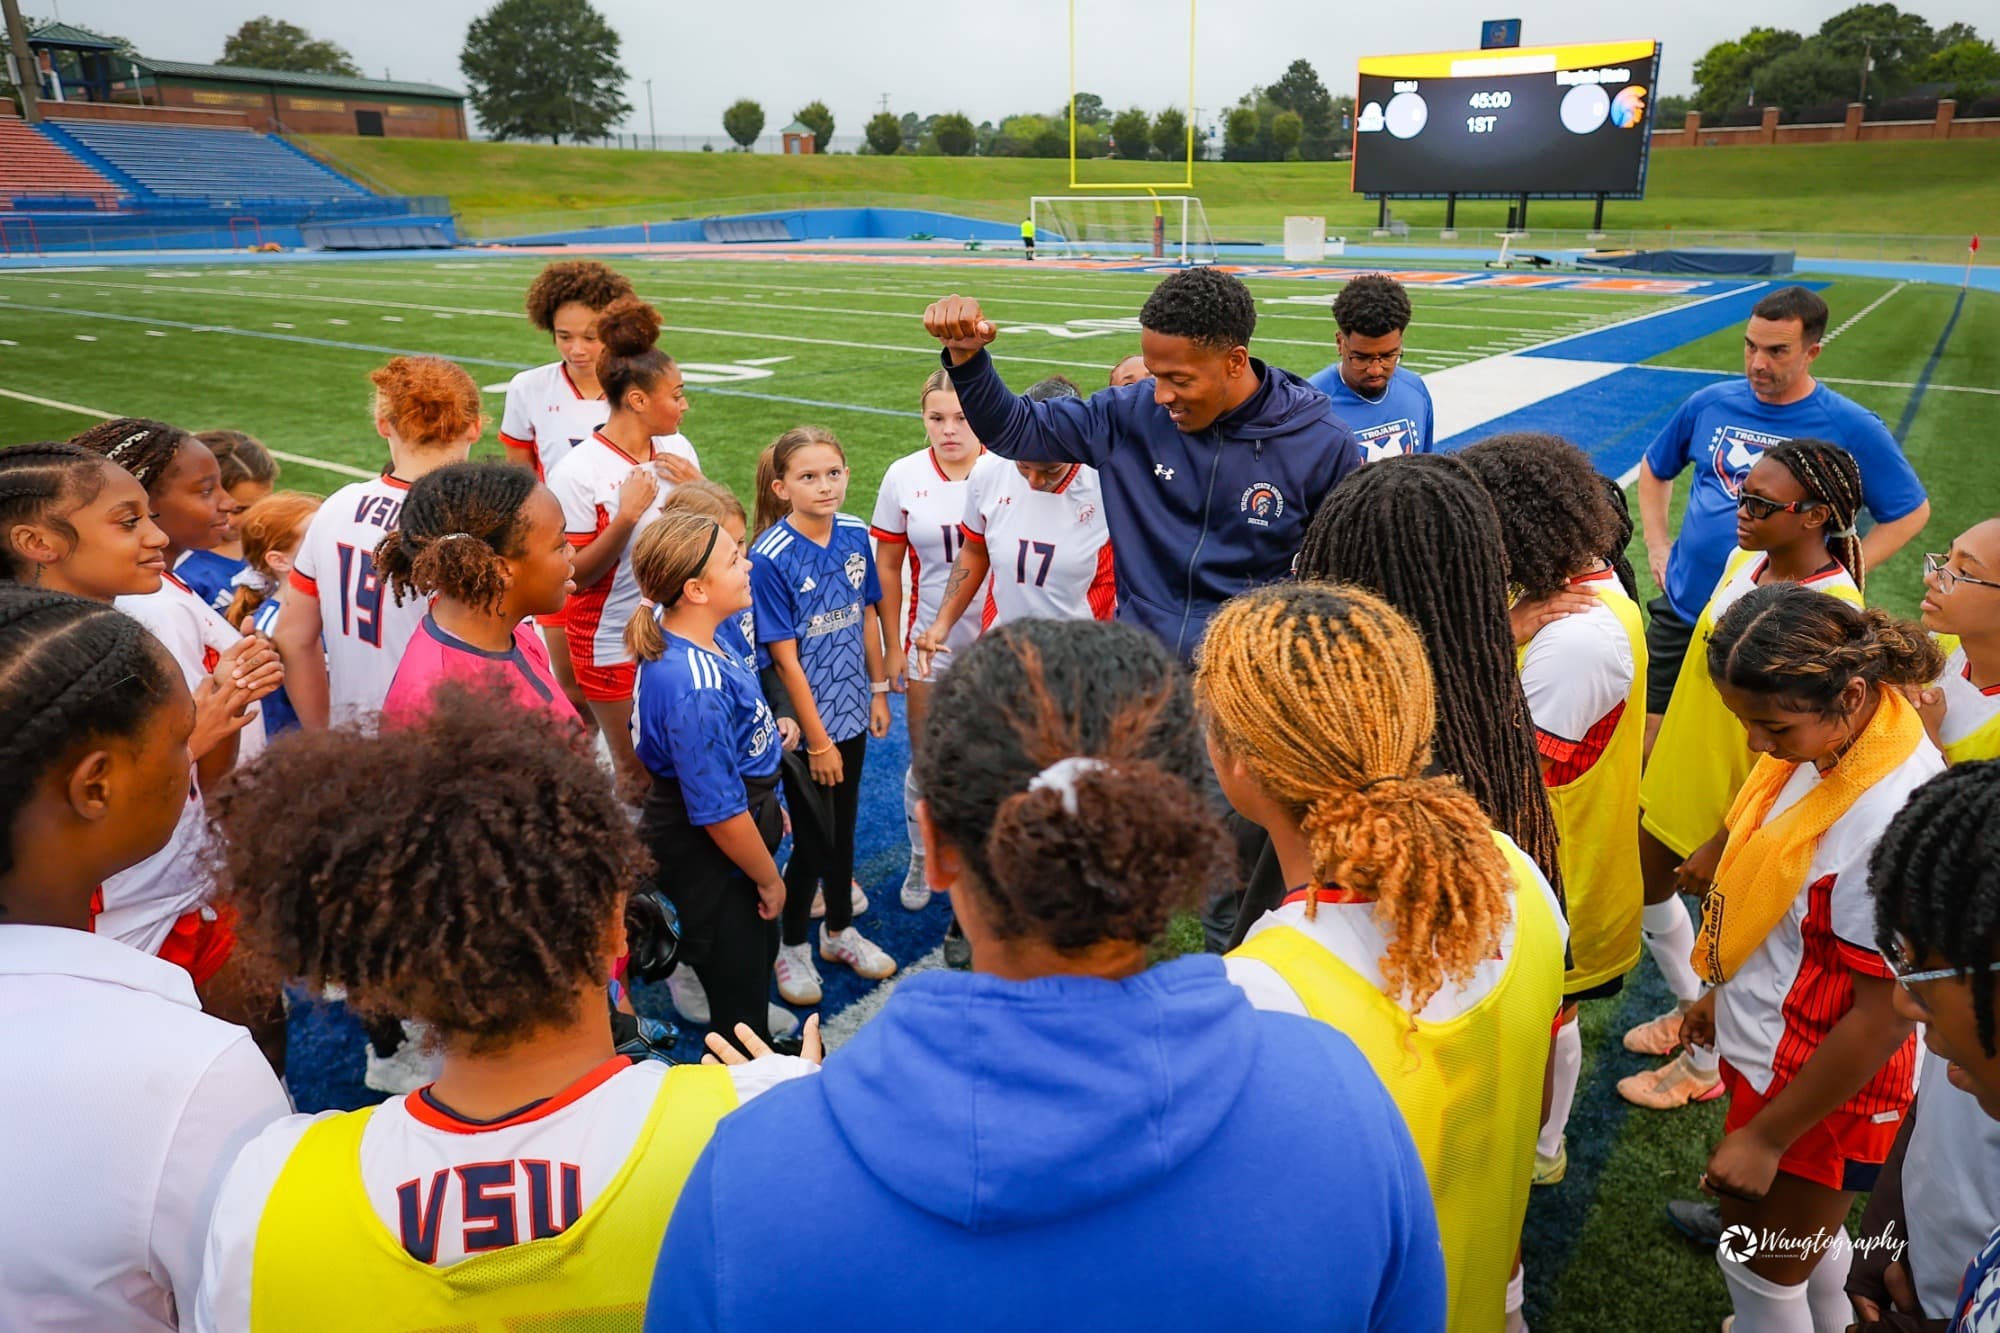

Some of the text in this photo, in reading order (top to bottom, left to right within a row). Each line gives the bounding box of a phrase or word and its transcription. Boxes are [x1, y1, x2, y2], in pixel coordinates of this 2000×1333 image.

[1469, 91, 1512, 109] 45:00
[1467, 116, 1497, 133] 1ST
[1361, 424, 1401, 440] TROJANS
[1016, 538, 1056, 587] 17
[336, 541, 386, 649] 19
[396, 1158, 583, 1265] VSU
